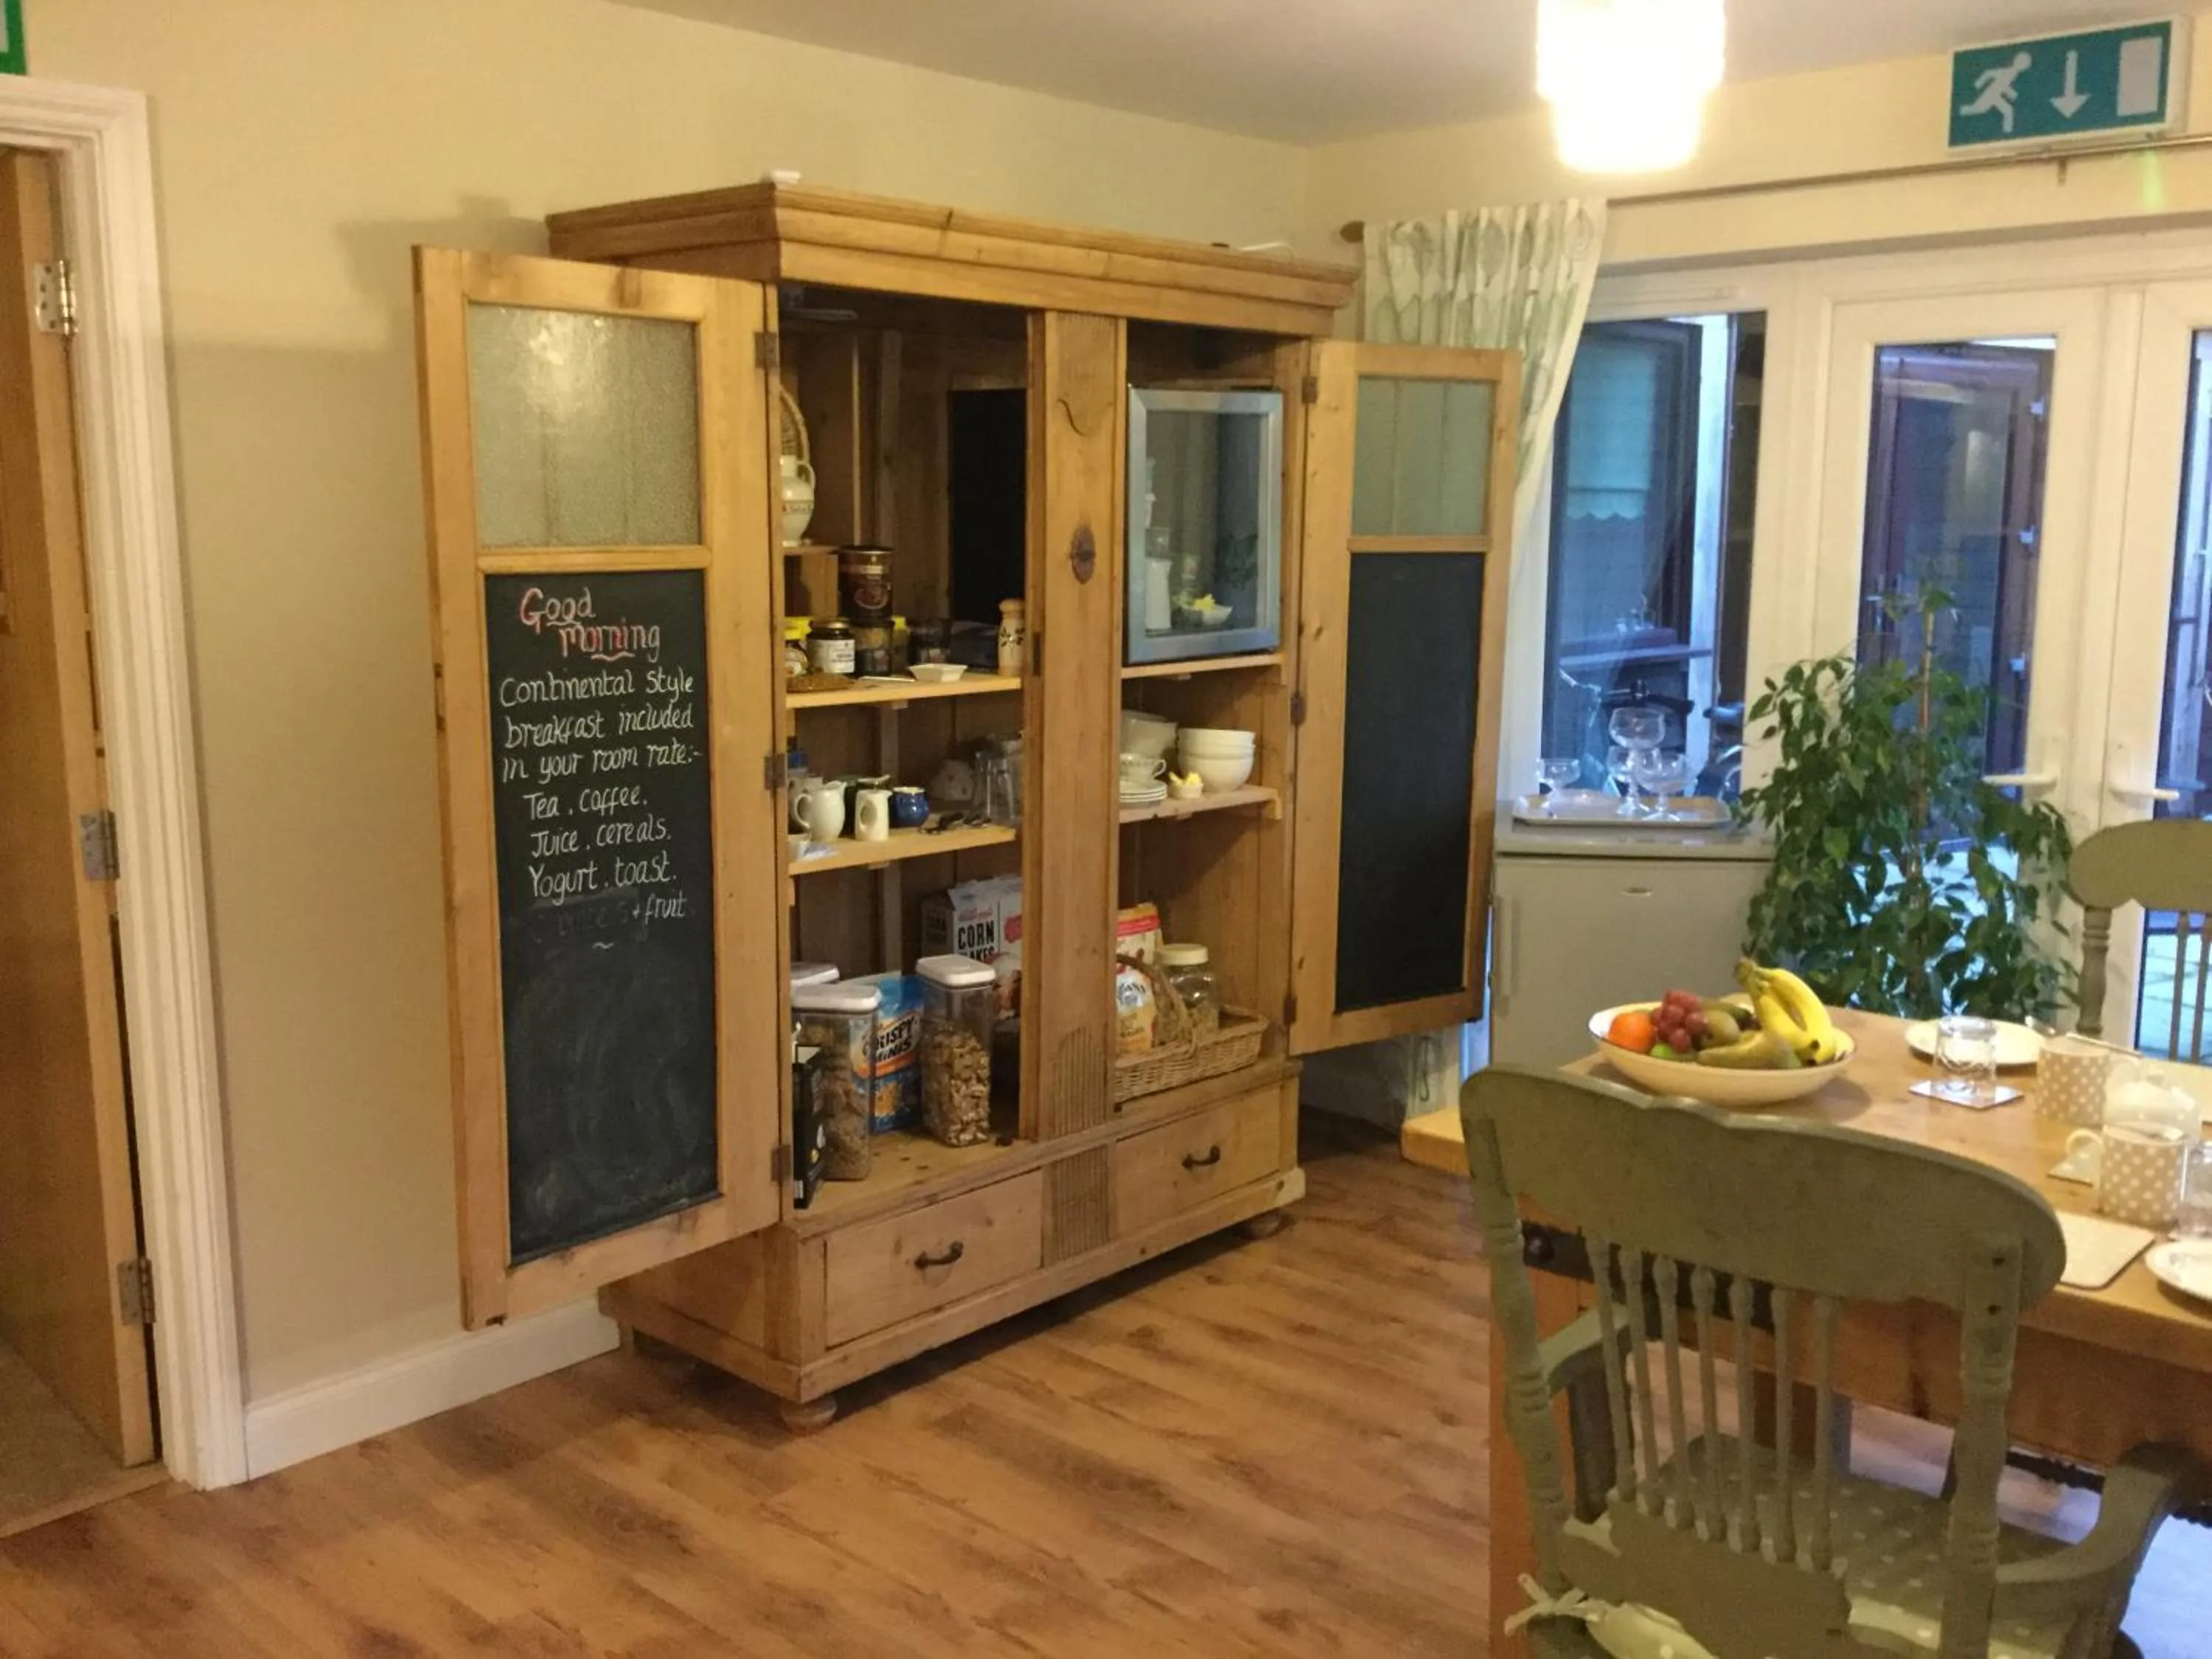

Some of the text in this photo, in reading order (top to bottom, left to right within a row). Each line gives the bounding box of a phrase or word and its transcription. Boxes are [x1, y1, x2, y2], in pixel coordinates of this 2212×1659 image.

[521, 588, 596, 634] Good
[504, 701, 694, 748] breakfast included
[538, 752, 584, 785] your
[592, 747, 639, 773] room
[958, 919, 995, 950] CORN
